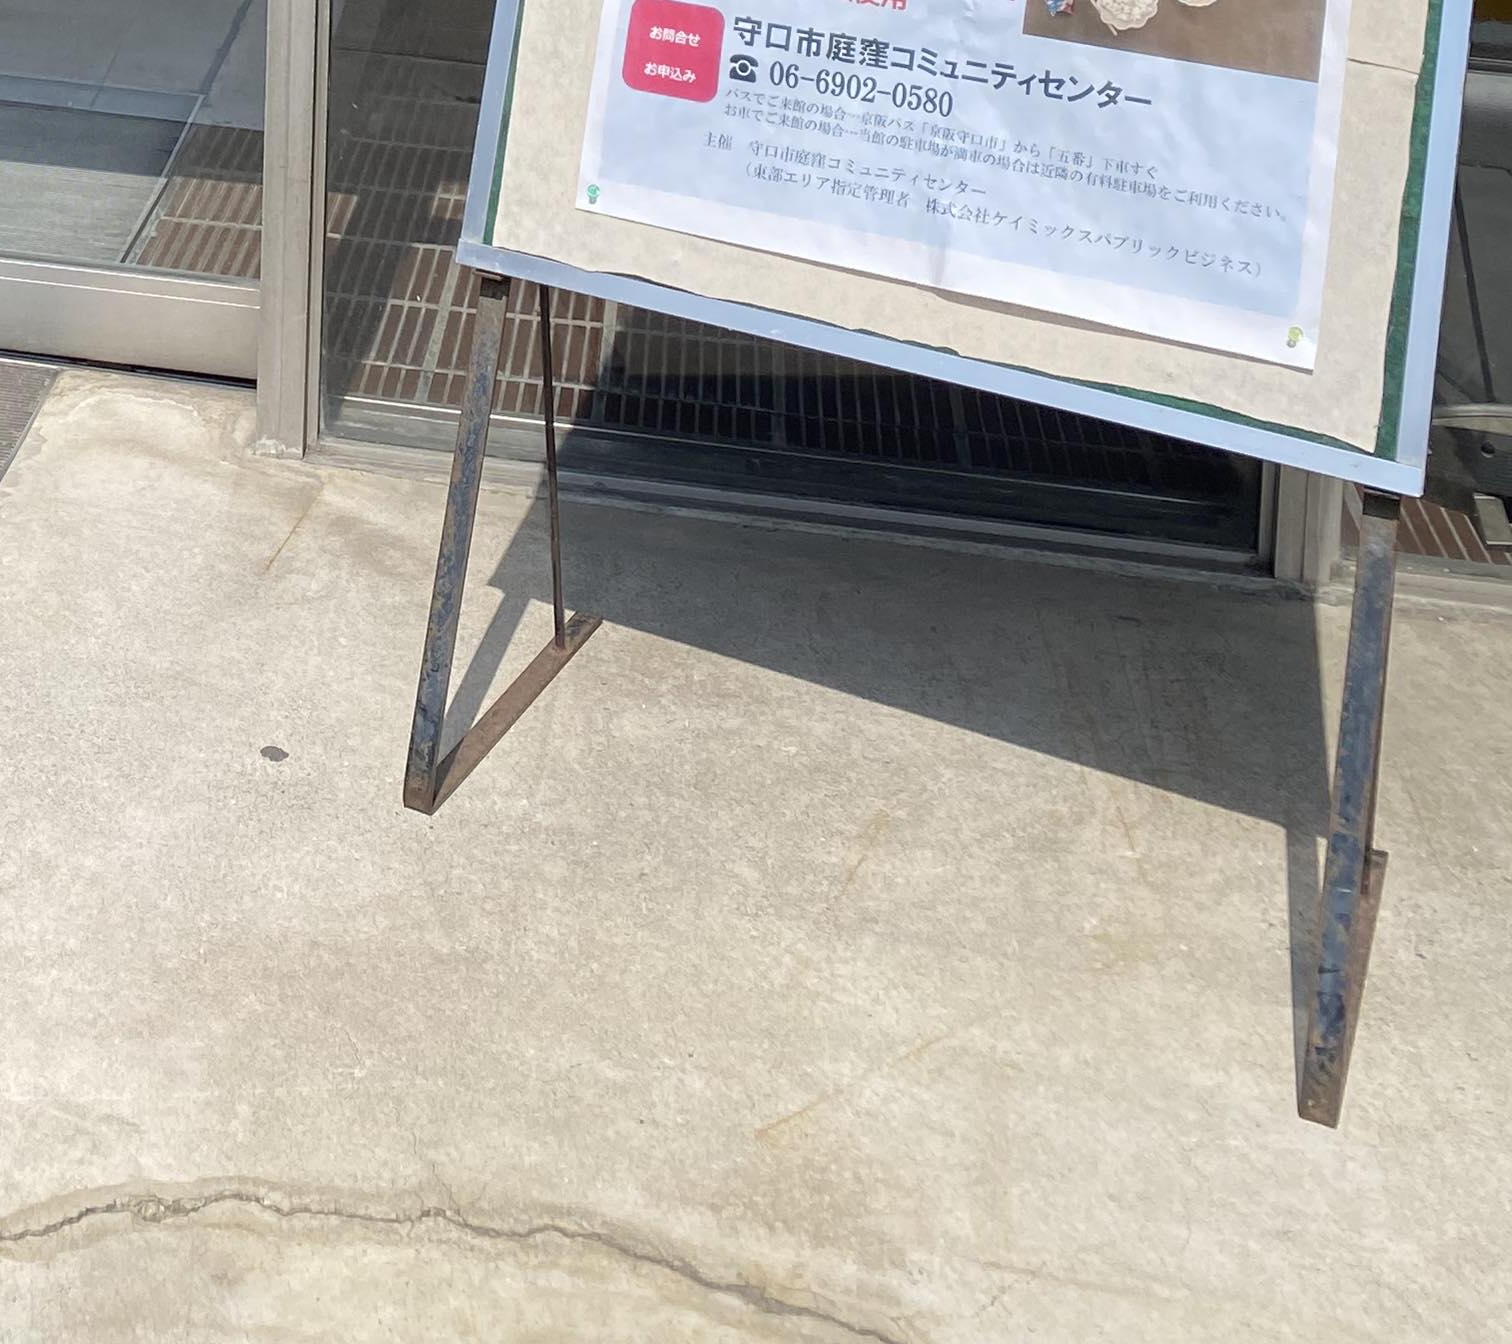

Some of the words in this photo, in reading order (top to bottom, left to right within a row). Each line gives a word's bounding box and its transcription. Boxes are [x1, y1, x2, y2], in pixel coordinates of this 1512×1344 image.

[648, 25, 702, 48] お問合せ
[732, 15, 1153, 109] 守口市庭窪コミュニティセンター
[643, 61, 697, 84] お申込み
[769, 60, 954, 118] 06-6902-0580
[703, 129, 734, 152] 主催
[749, 139, 987, 196] 守口市庭窪コミュニティセンター
